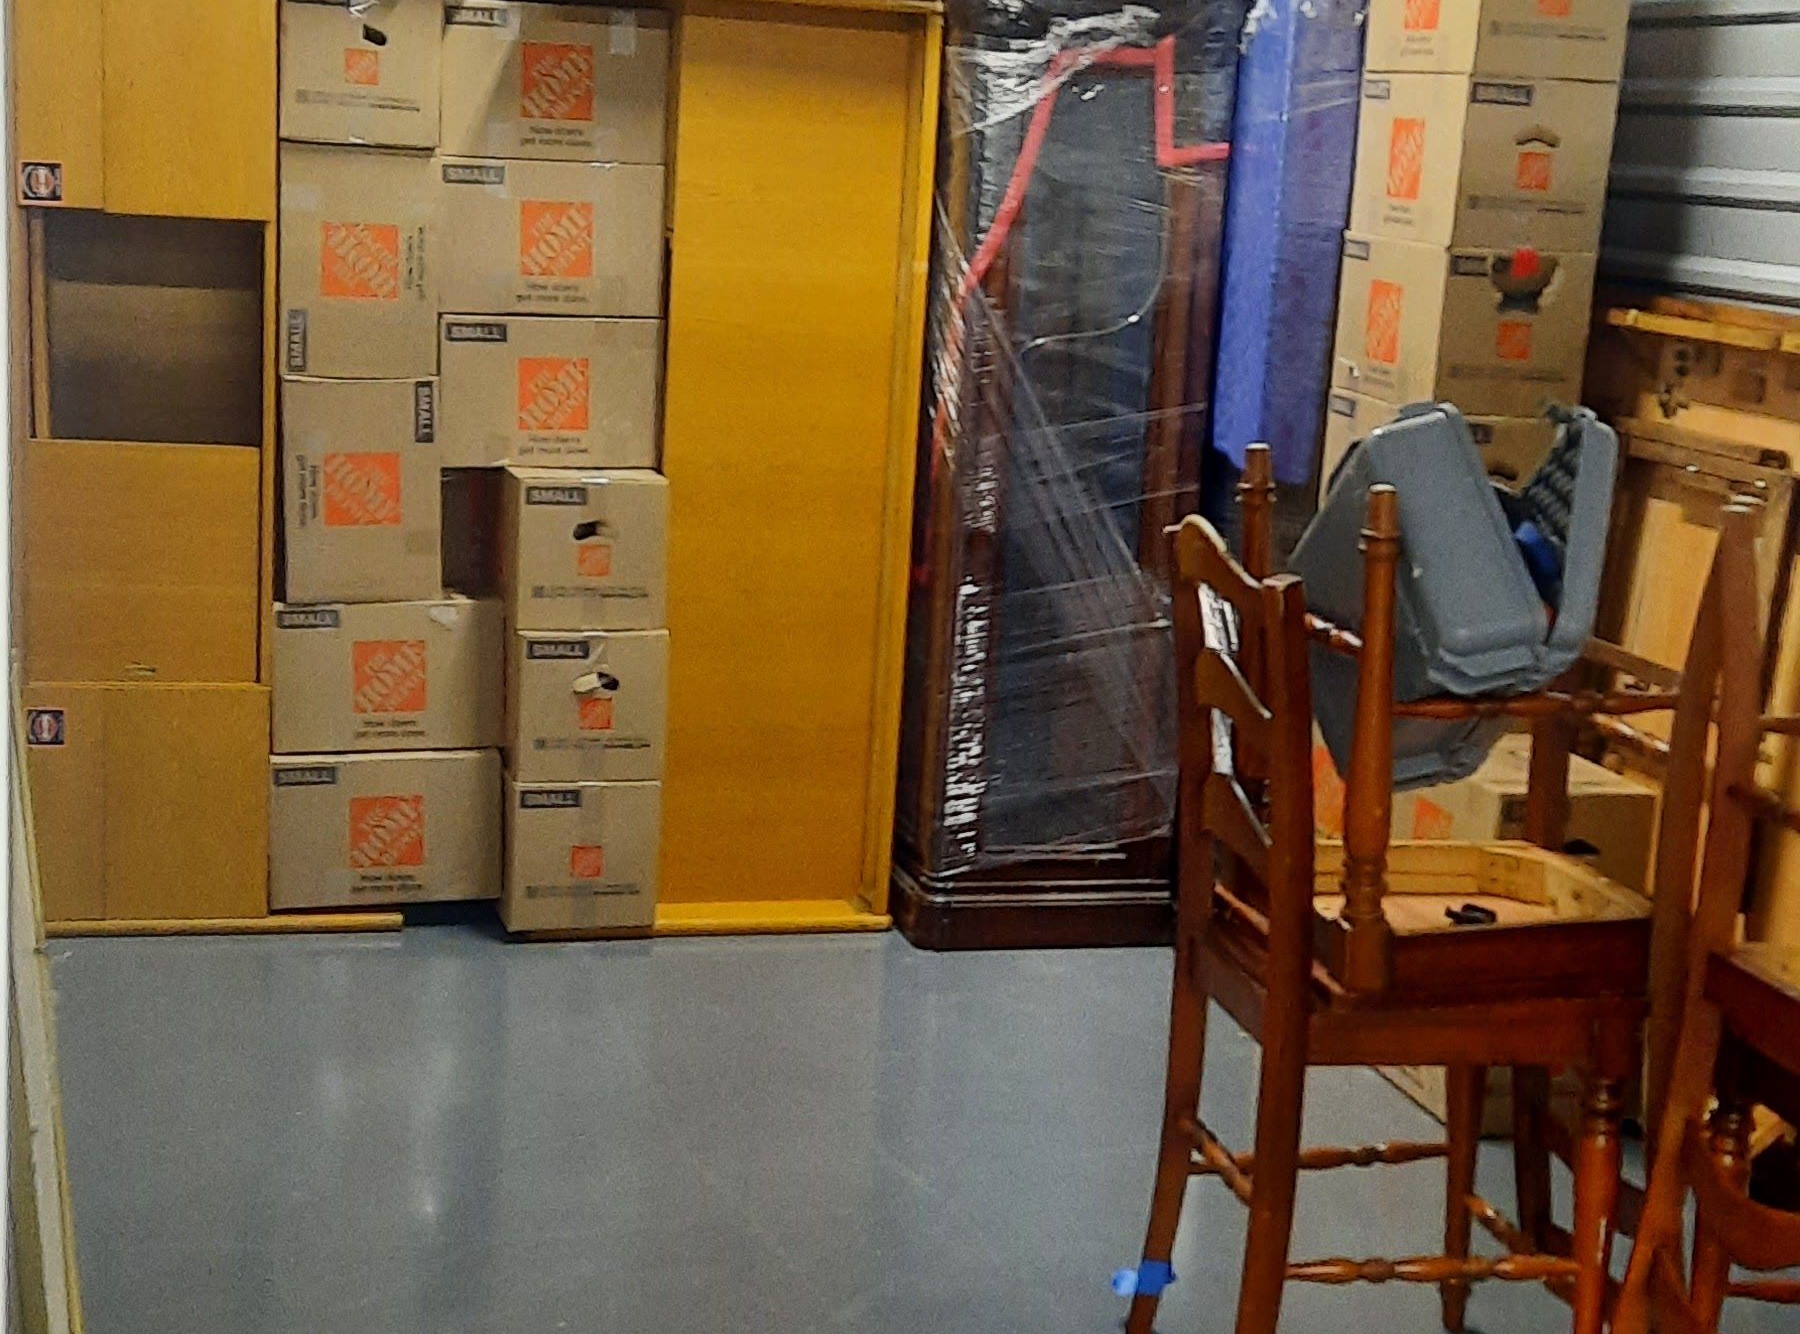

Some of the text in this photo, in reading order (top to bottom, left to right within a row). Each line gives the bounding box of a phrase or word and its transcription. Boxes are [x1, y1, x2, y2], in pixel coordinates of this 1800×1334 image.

[521, 50, 592, 118] HOME
[447, 168, 500, 182] SMALL
[521, 204, 592, 274] HOME
[519, 361, 586, 431] HOME
[531, 489, 581, 503] SMALL
[354, 643, 423, 712] HOME
